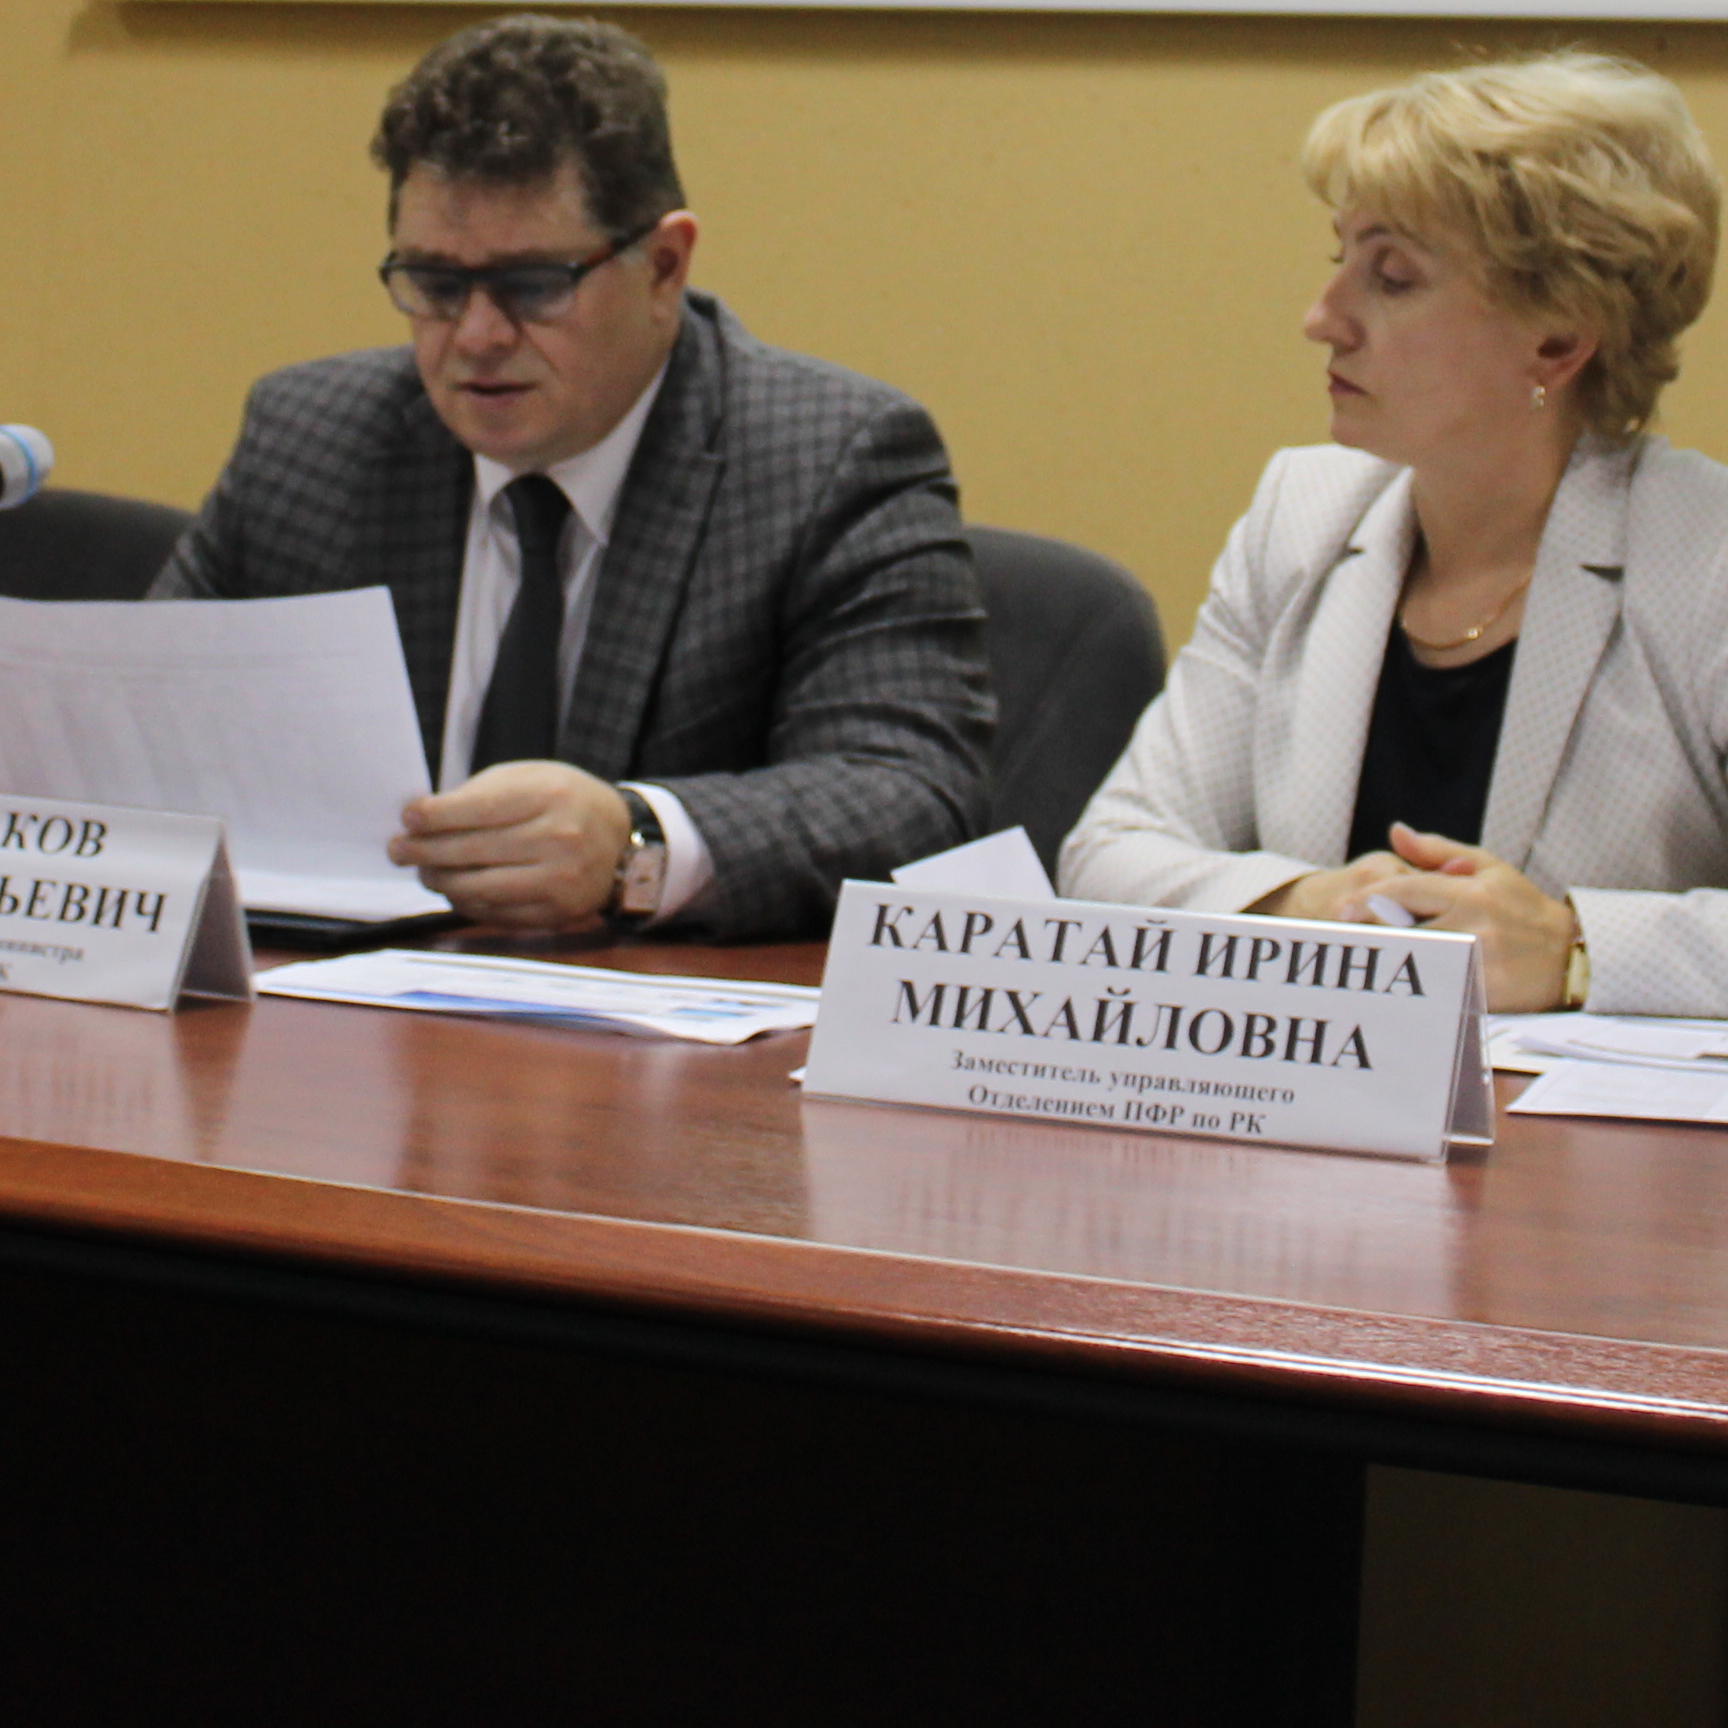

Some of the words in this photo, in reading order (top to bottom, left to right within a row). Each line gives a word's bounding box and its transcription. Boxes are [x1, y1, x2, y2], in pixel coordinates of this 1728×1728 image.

[868, 902, 1177, 973] КАРАТАЙ
[1195, 930, 1427, 998] ИРИНА
[891, 979, 1376, 1072] МИХАЙЛОВНА
[950, 1049, 1101, 1086] Заместитель
[1108, 1068, 1297, 1107] управляющего
[966, 1084, 1116, 1122] Отделением
[1123, 1100, 1186, 1128] ПФР
[1191, 1111, 1223, 1132] по
[1227, 1110, 1268, 1135] РК
